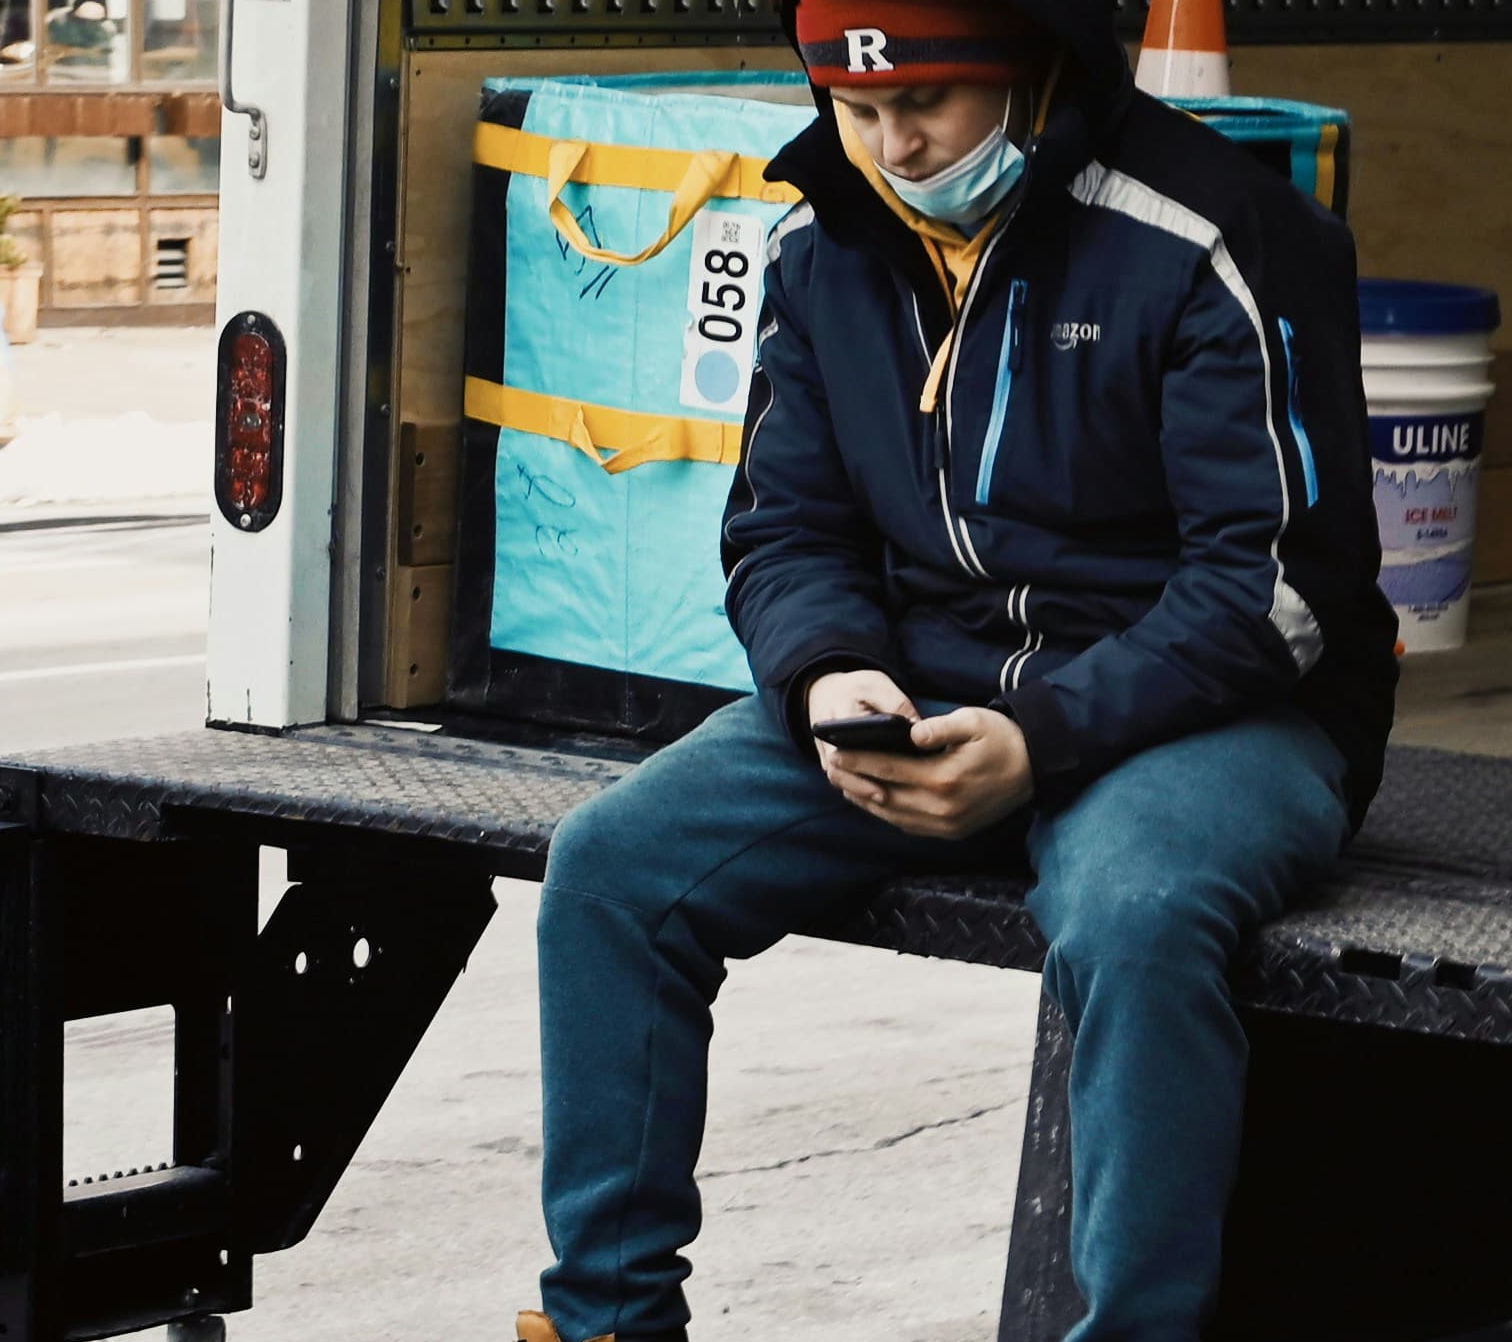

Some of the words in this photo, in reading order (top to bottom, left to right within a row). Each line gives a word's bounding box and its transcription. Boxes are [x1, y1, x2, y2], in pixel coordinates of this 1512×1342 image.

[844, 28, 894, 73] R
[698, 249, 749, 342] 058
[1393, 423, 1469, 455] ULINE
